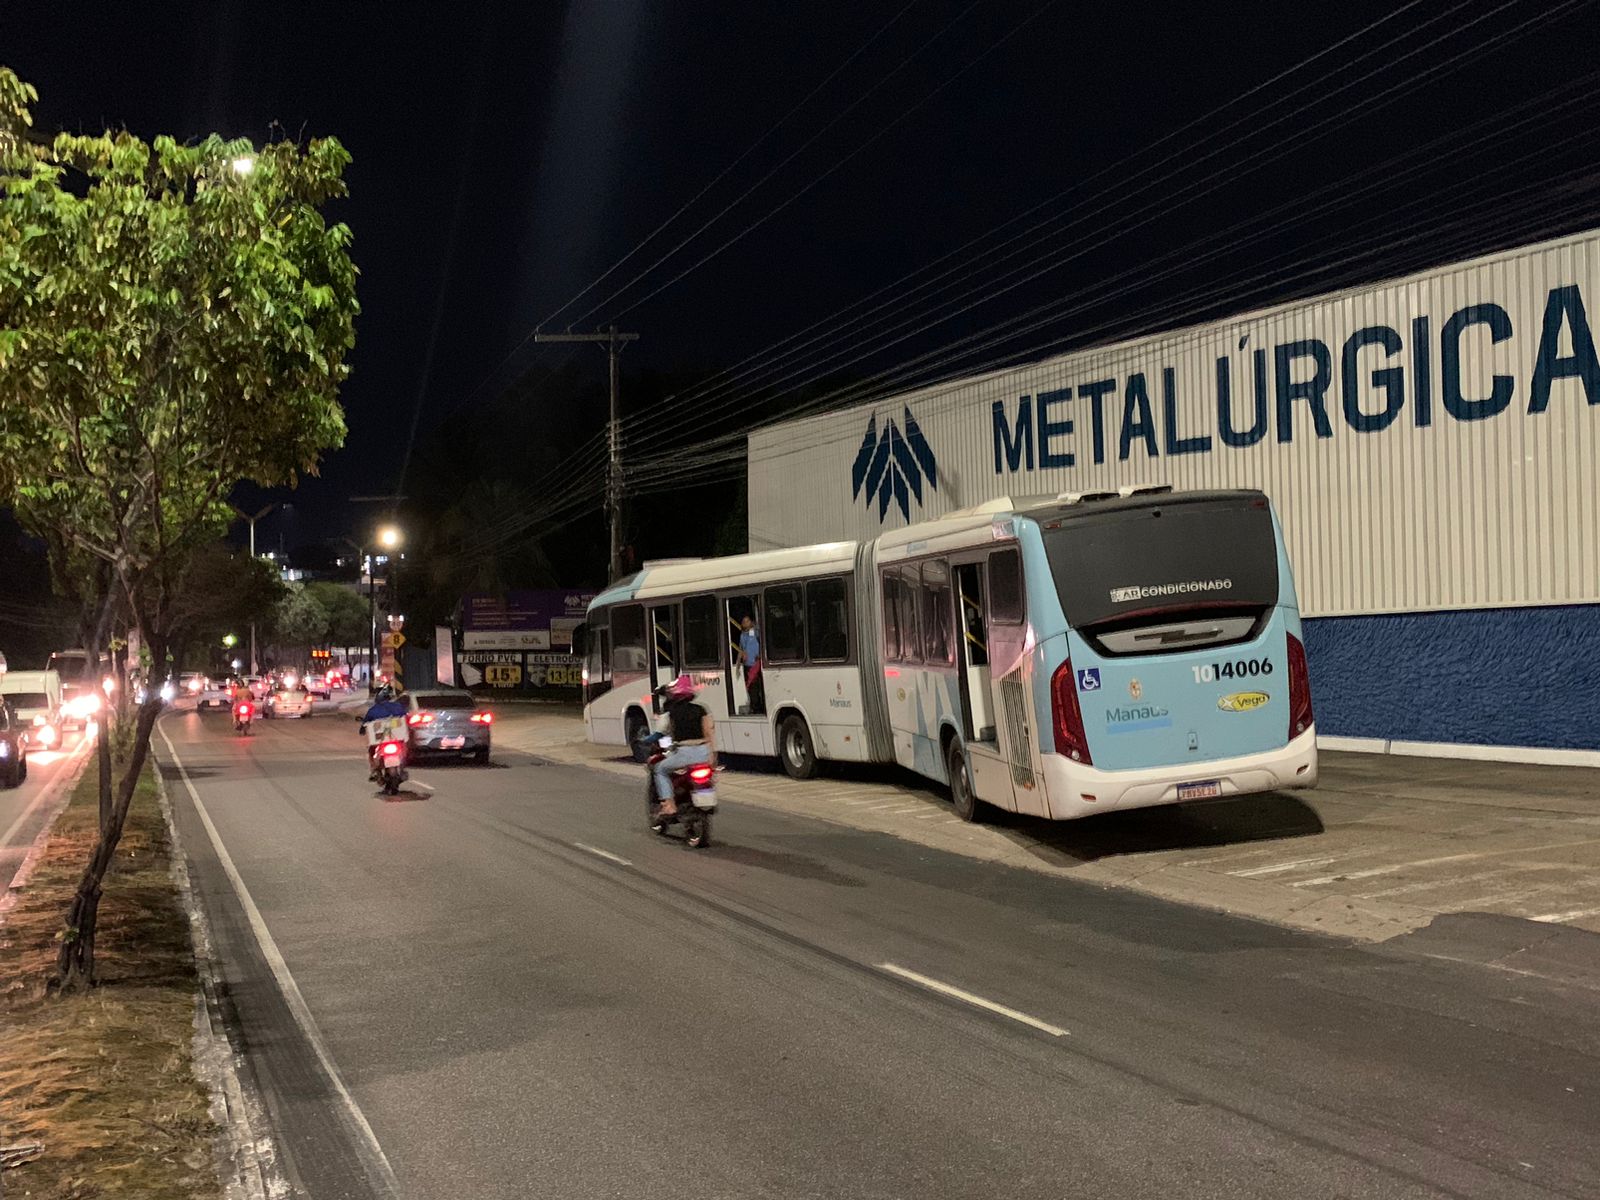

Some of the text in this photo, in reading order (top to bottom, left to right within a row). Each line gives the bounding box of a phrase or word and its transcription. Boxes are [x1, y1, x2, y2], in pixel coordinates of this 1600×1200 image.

[992, 284, 1600, 474] METALÚRGICA
[1123, 579, 1232, 599] AR CONDICIONADO
[462, 654, 495, 663] FORRO
[1192, 657, 1273, 684] 1014006
